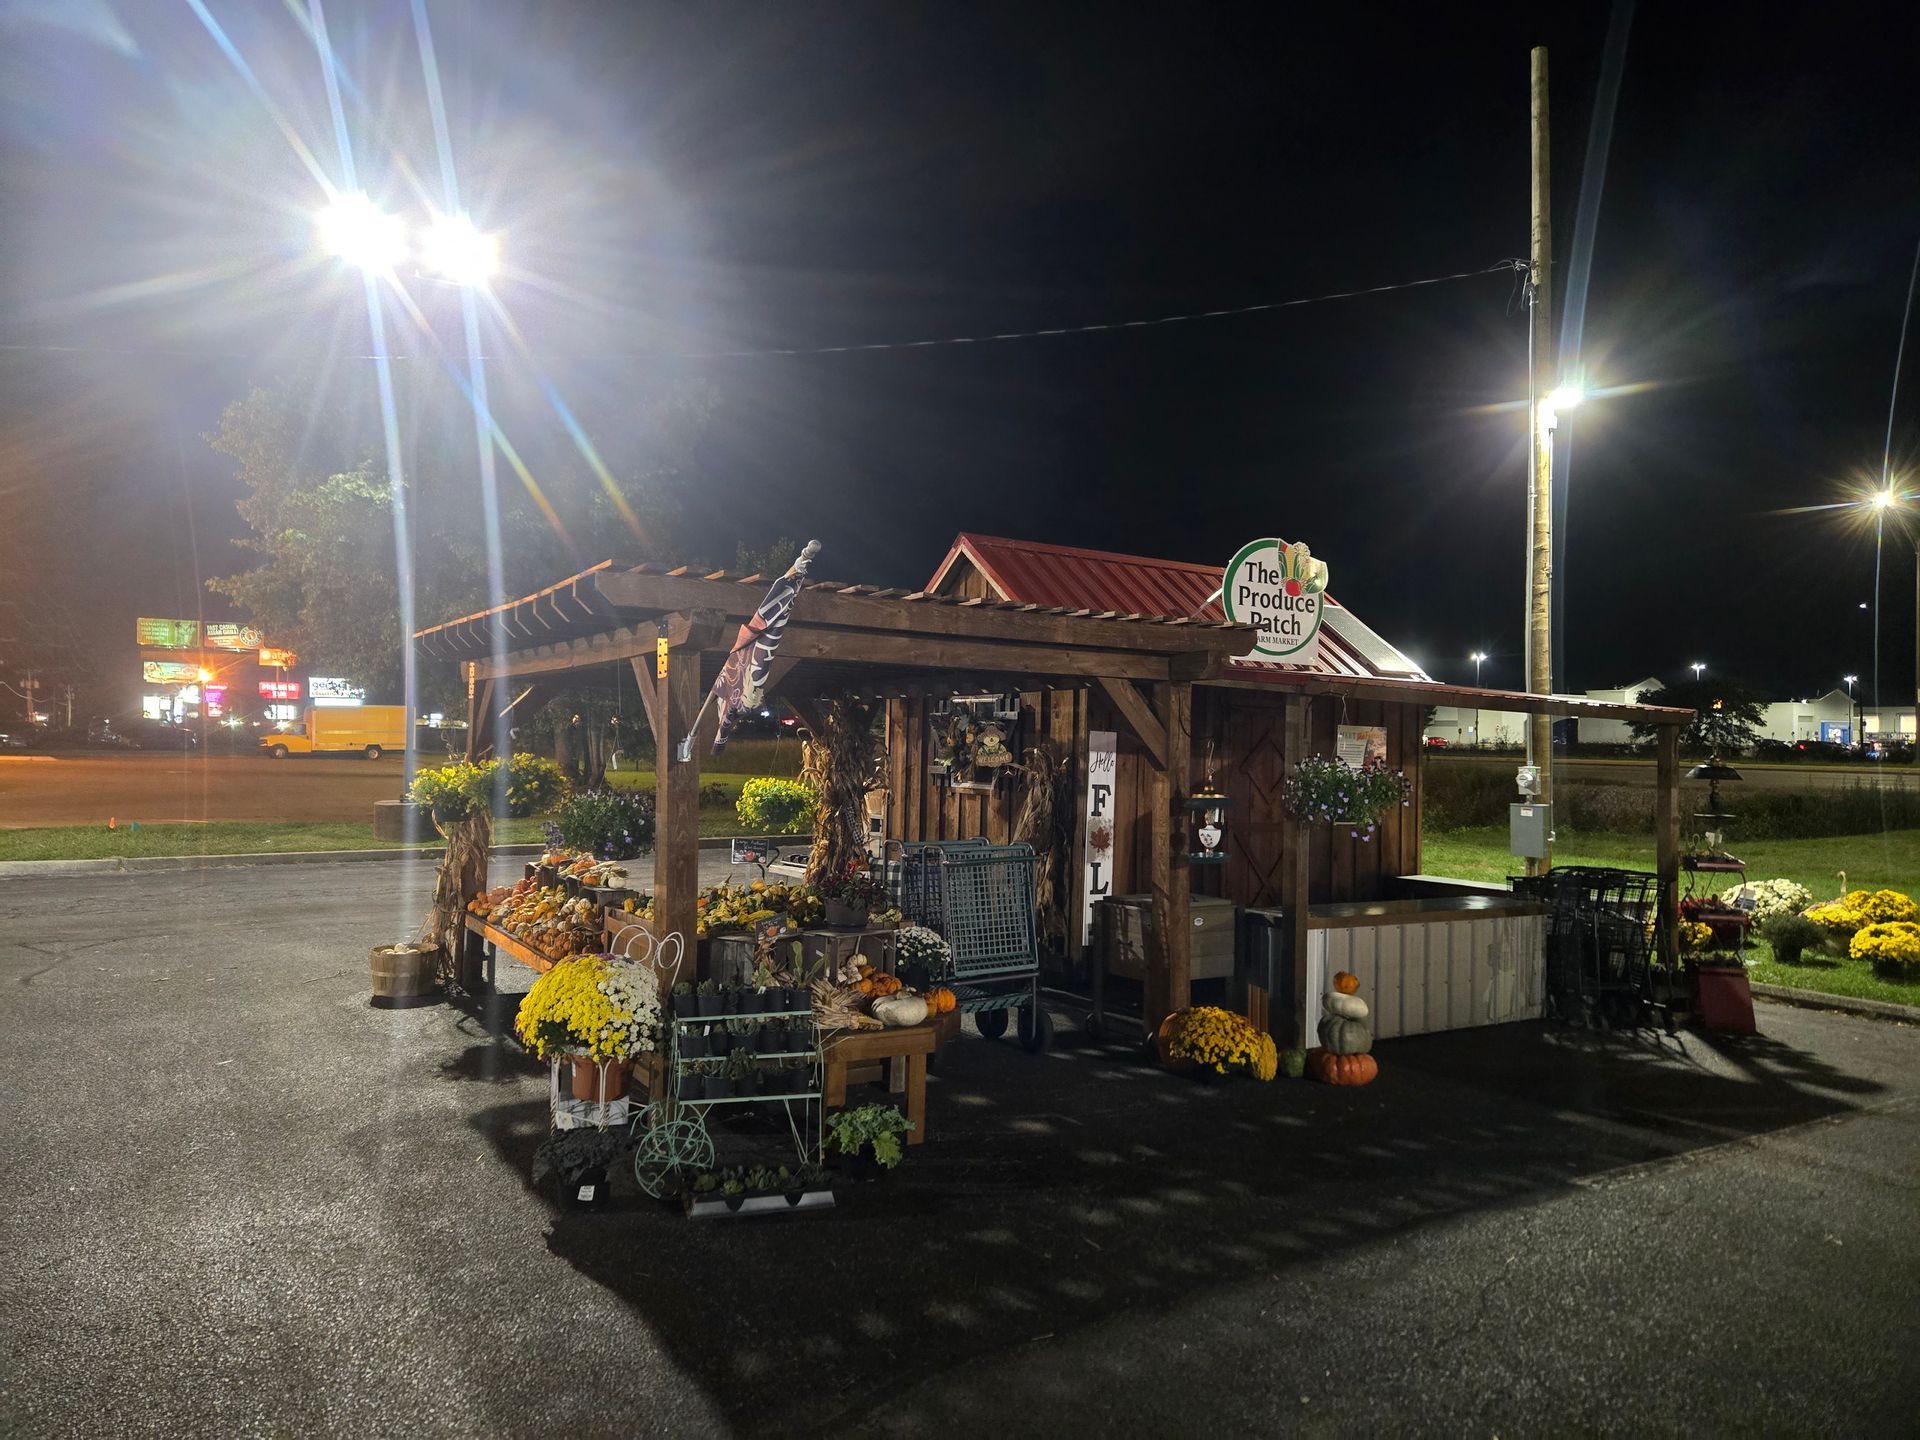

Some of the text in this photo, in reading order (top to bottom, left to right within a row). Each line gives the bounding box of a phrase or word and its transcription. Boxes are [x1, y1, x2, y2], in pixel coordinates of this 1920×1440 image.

[1244, 561, 1280, 586] The
[1238, 584, 1316, 614] Produce
[1250, 611, 1302, 636] Patch
[1256, 635, 1300, 646] ARM MARKET
[977, 753, 1011, 763] WELCOME
[1090, 751, 1115, 773] Hello
